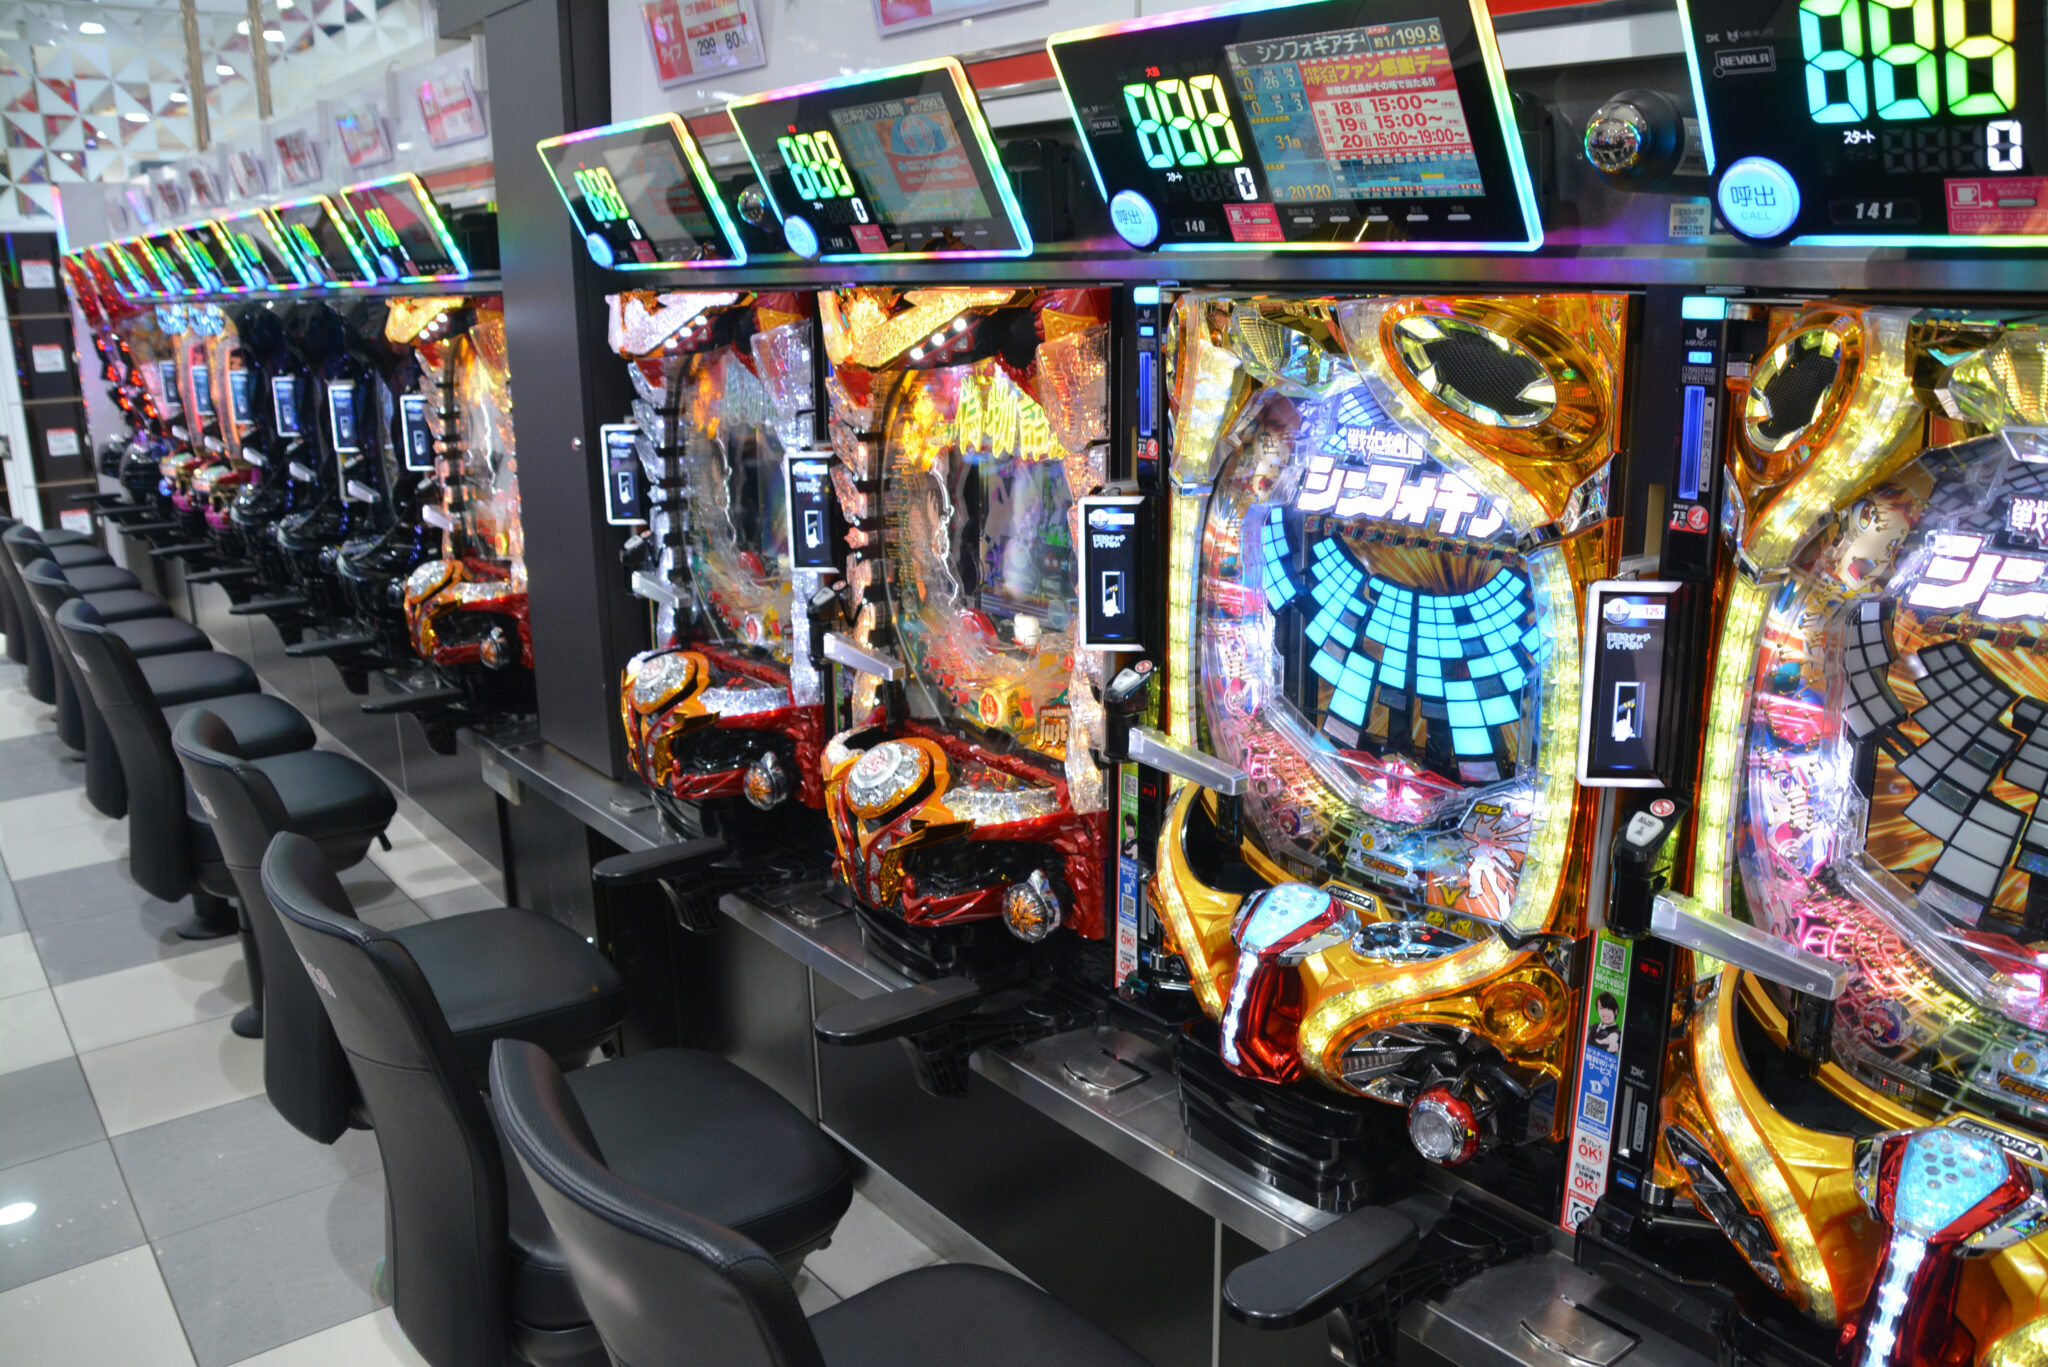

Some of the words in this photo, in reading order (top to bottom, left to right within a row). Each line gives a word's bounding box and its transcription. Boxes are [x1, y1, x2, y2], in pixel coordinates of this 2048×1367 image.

[1243, 76, 1254, 92] 0
[1263, 76, 1280, 89] 26
[1286, 74, 1296, 88] 3
[1251, 100, 1261, 115] 0
[1275, 101, 1284, 114] 5
[1294, 99, 1303, 112] 3
[1844, 130, 1875, 144] スタート
[1987, 120, 2022, 171] 0
[1234, 166, 1258, 201] 0
[1288, 184, 1332, 200] 20120
[1730, 184, 1776, 208] 呼出
[851, 197, 869, 224] 0
[1115, 209, 1142, 225] 呼出
[1740, 211, 1771, 221] CALL
[1855, 202, 1894, 219] 141
[1185, 220, 1206, 233] 140
[1305, 515, 1517, 564] SYMPHOGEAR
[1606, 632, 1652, 642] 画面をタッチ
[1606, 640, 1644, 651] して下さい
[1474, 804, 1503, 816] GO
[1630, 1065, 1646, 1079] DK
[1578, 1143, 1603, 1162] OK!
[1574, 1177, 1599, 1194] OK!
